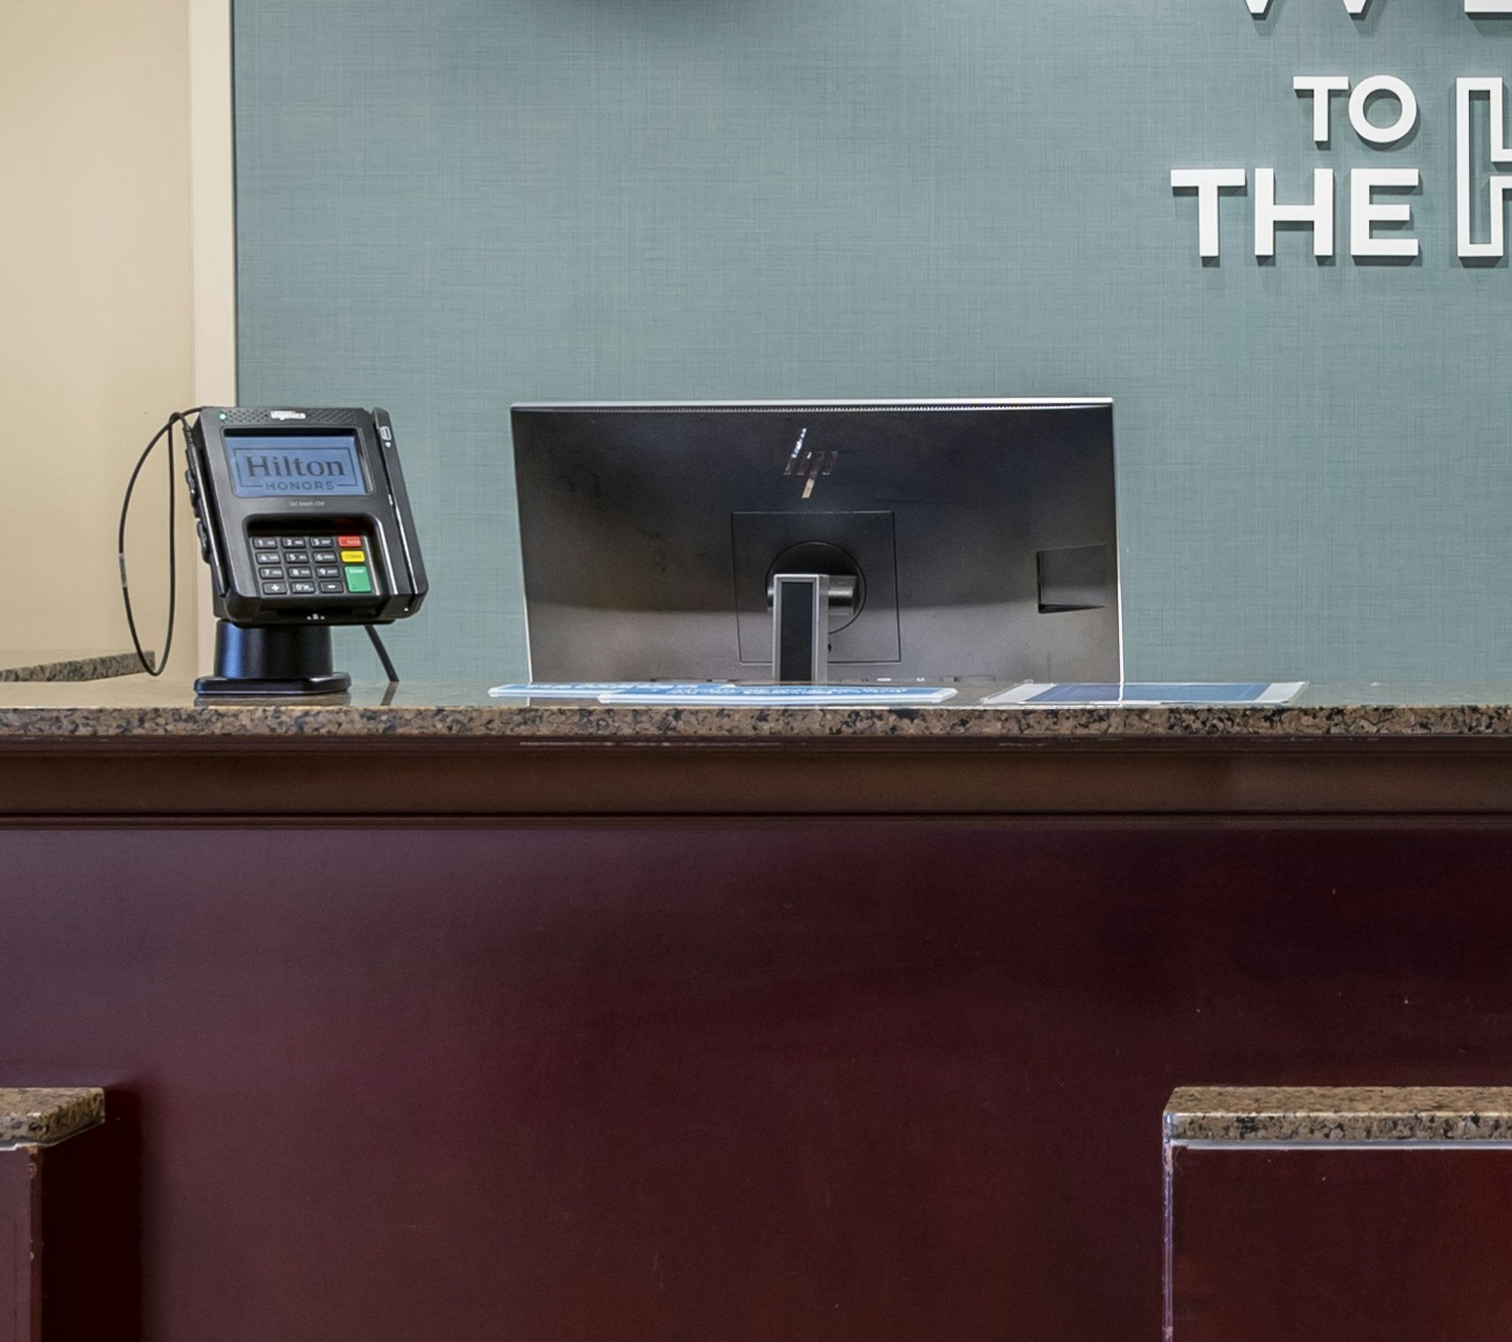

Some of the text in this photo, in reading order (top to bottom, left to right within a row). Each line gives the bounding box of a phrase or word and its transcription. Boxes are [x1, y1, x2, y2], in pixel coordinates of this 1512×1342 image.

[1293, 74, 1418, 145] TO
[1170, 167, 1421, 259] THE
[245, 454, 346, 479] Hilton
[265, 480, 336, 492] HONORS
